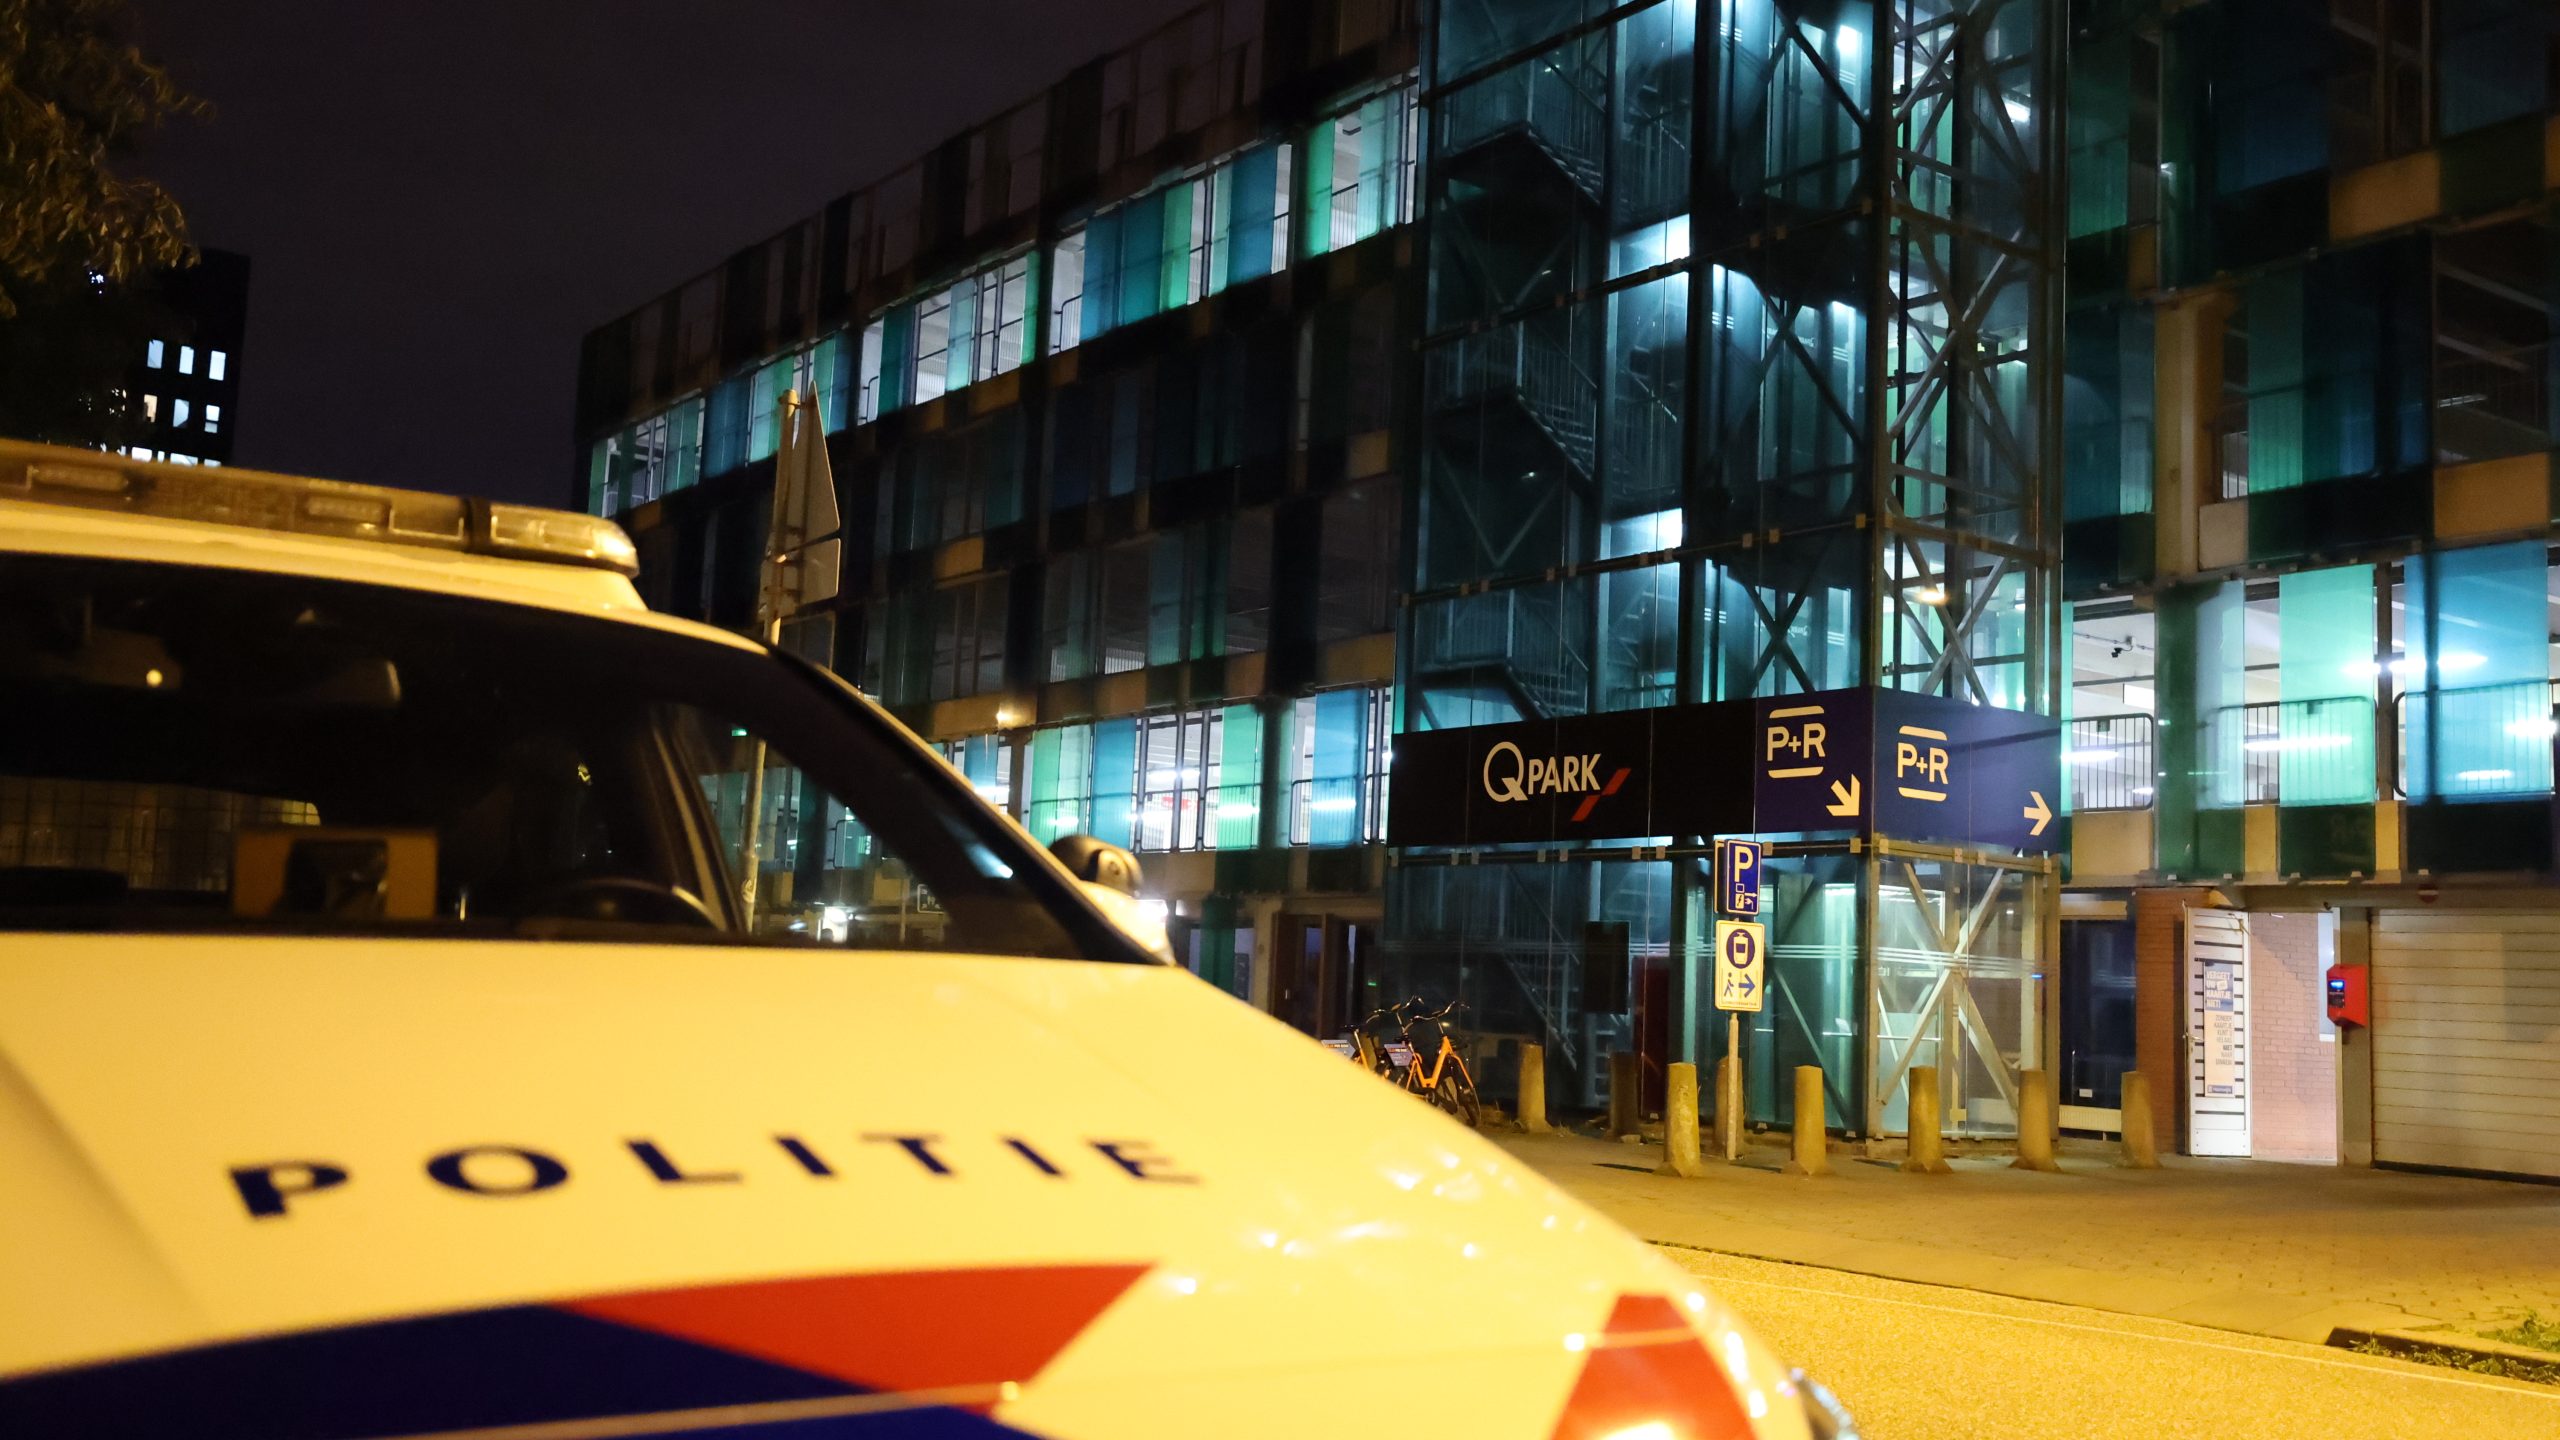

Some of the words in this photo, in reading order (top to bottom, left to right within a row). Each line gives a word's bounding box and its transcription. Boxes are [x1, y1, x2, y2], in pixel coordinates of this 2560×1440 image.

[1767, 722, 1826, 762] P+R
[1897, 742, 1949, 785] P+R
[1734, 845, 1753, 883] P
[228, 1135, 1200, 1219] POLITIE
